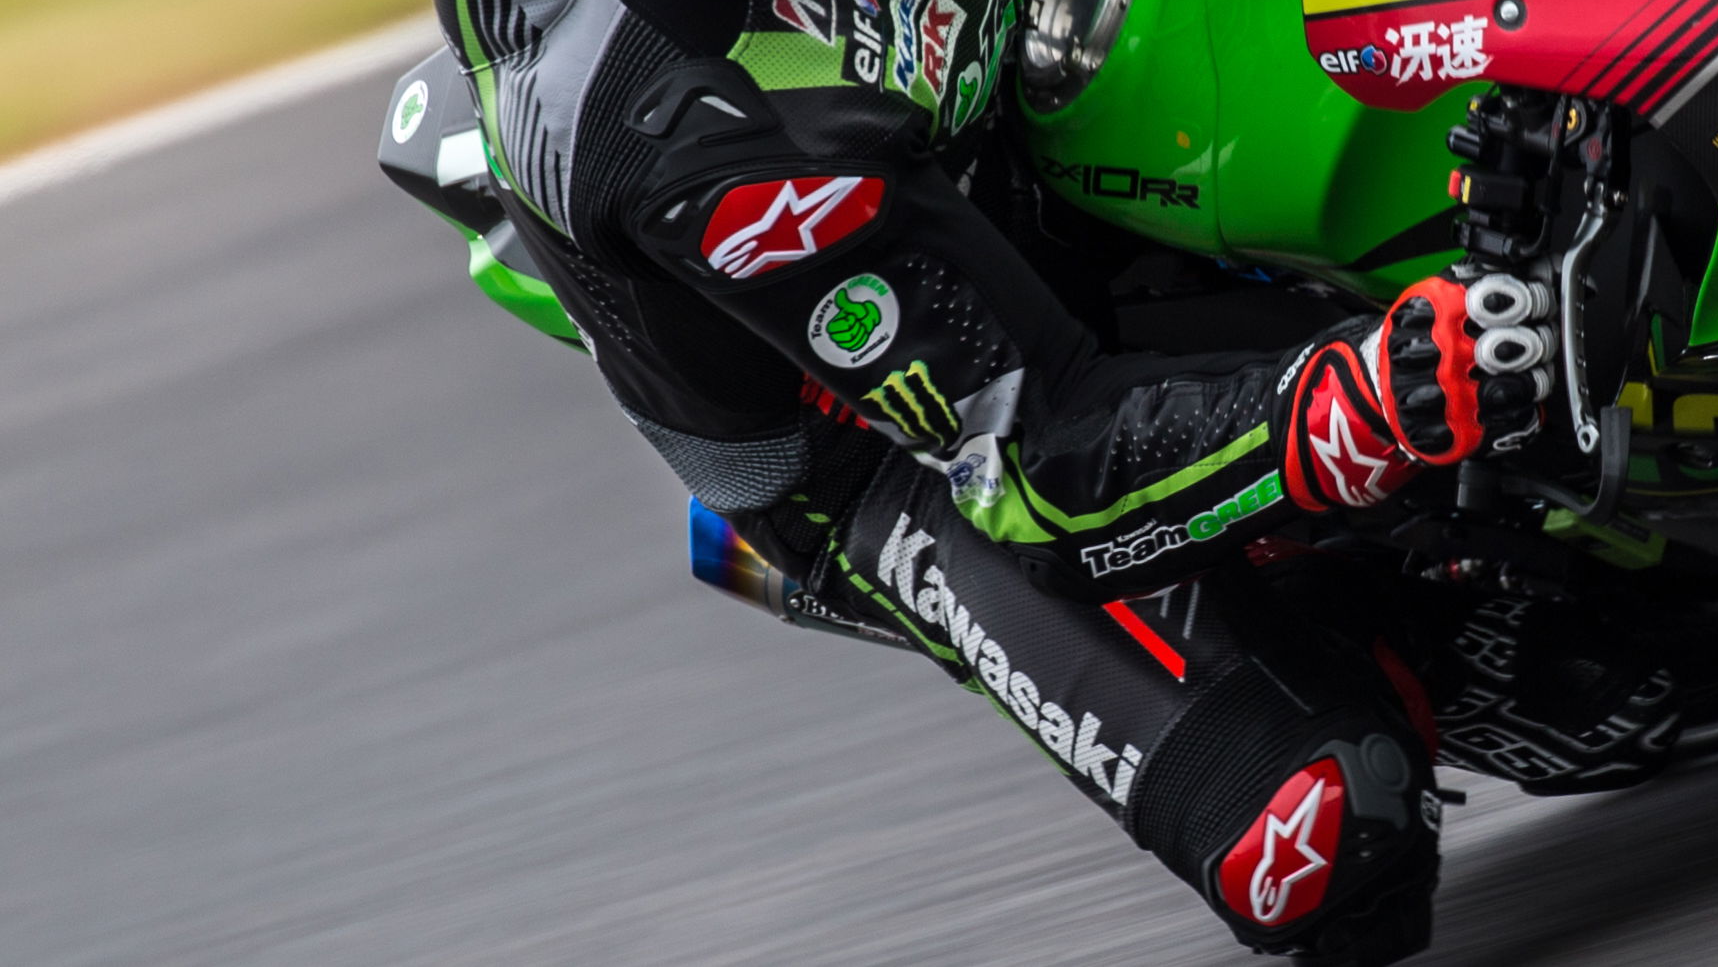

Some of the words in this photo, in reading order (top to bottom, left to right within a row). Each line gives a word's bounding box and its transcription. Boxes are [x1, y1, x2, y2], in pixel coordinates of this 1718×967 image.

[852, 10, 882, 84] elf
[1319, 49, 1360, 74] elf
[1080, 468, 1285, 579] TeamGREE
[877, 512, 1143, 806] Kawasaki
